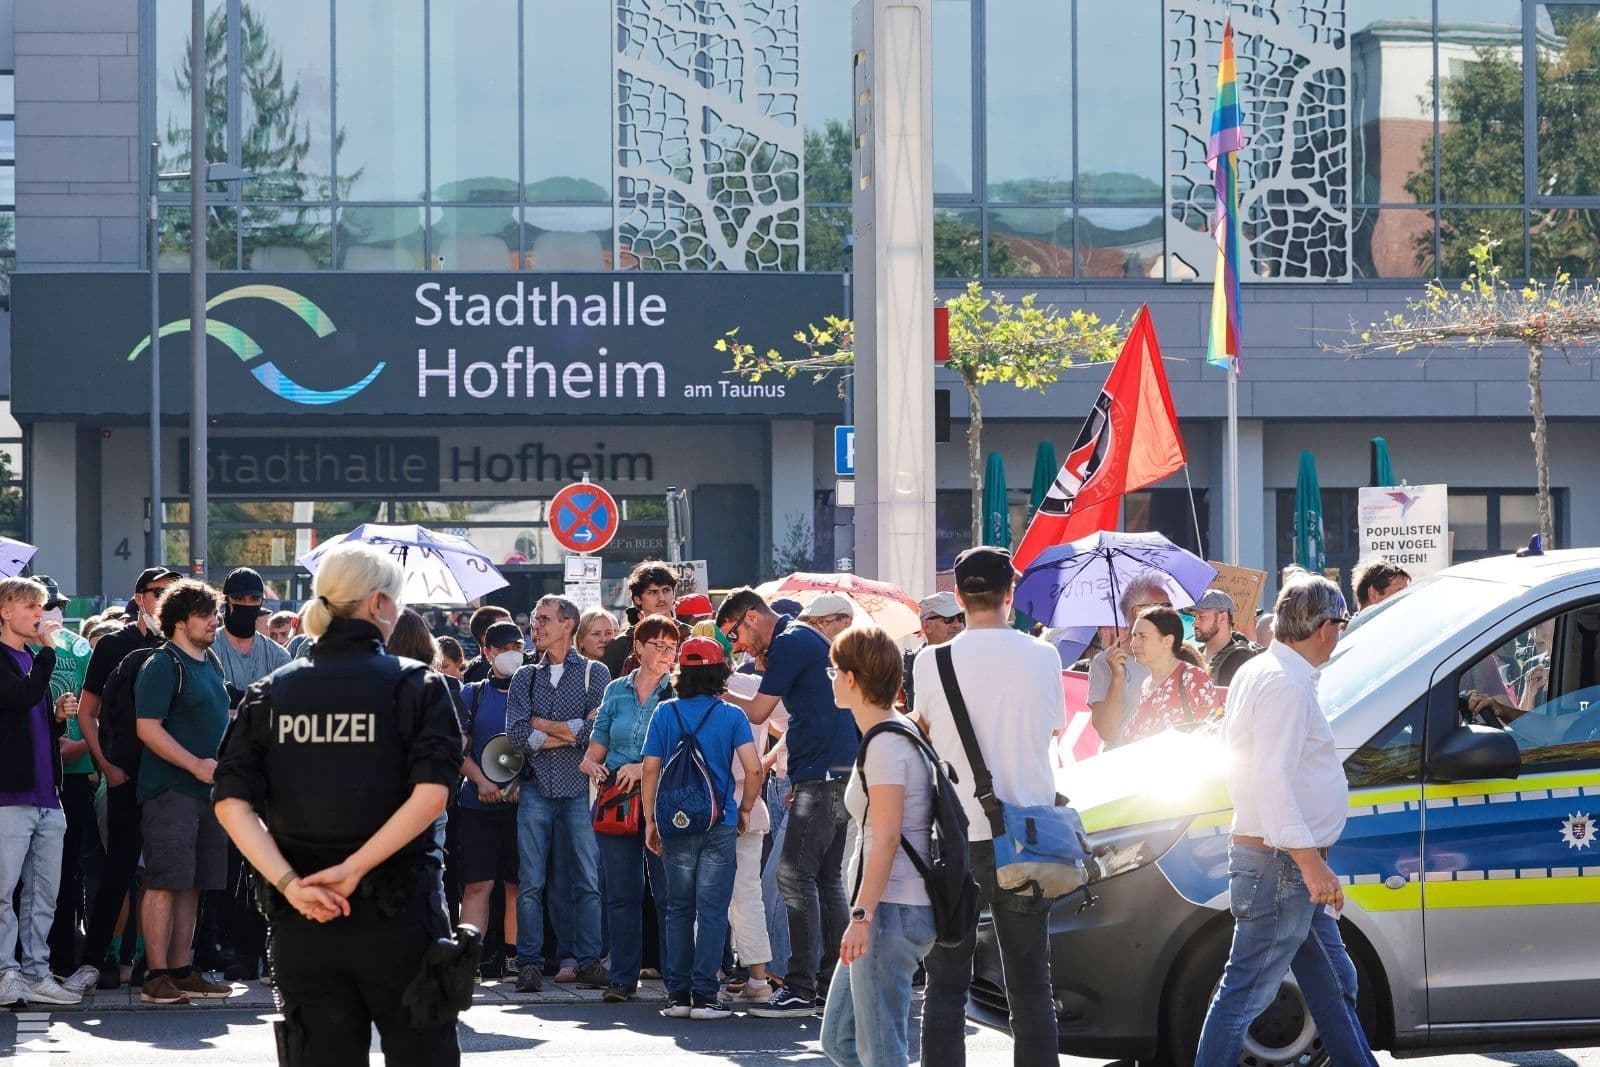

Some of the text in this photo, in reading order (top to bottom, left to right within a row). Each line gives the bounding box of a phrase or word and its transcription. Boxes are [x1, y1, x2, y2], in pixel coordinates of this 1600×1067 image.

[415, 282, 667, 327] Stadthalle
[418, 346, 786, 399] Hofheim am Taunus
[453, 441, 653, 483] Hofheim
[635, 538, 663, 549] BEER
[1366, 525, 1441, 537] POPULISTEN
[114, 537, 132, 560] 4
[1371, 539, 1437, 551] DEN VOGEL
[278, 713, 376, 744] POLIZEI
